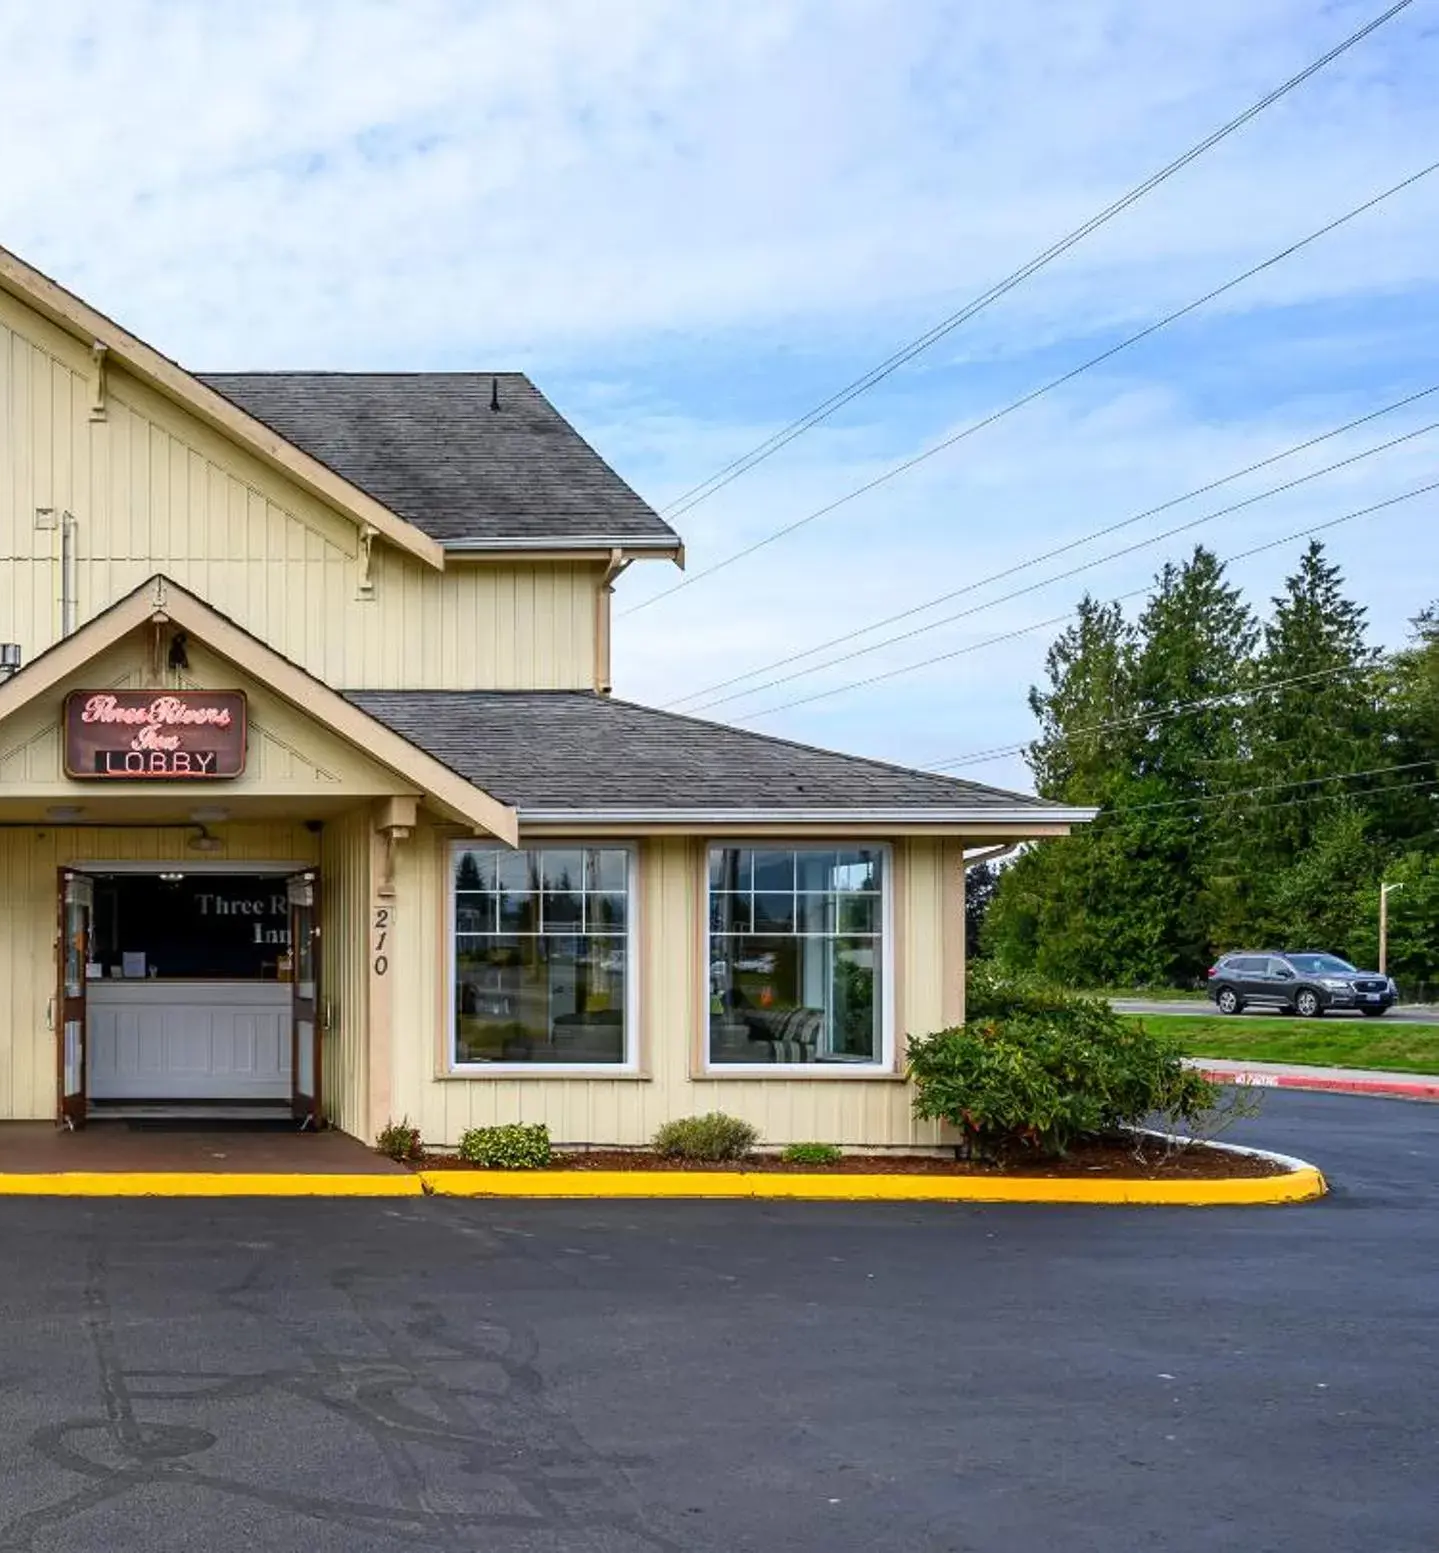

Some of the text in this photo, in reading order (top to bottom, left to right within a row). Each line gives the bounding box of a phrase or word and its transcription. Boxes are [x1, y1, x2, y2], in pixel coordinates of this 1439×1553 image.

[81, 695, 231, 727] Three Rivers
[131, 725, 181, 750] Inn
[106, 752, 213, 773] LOBBY
[194, 893, 287, 915] Three R
[253, 922, 290, 943] Inn
[375, 909, 388, 976] 210
